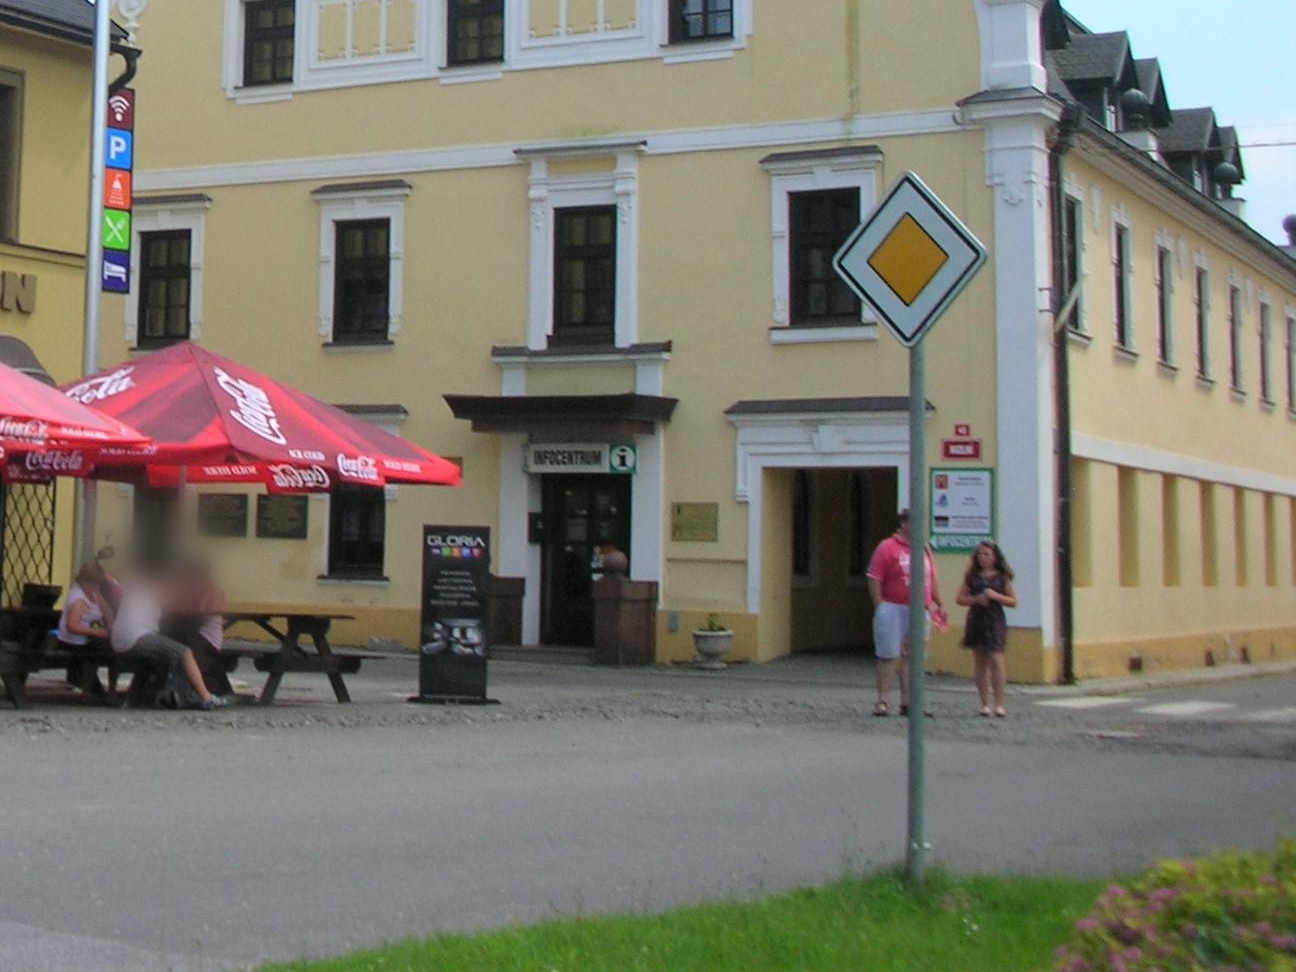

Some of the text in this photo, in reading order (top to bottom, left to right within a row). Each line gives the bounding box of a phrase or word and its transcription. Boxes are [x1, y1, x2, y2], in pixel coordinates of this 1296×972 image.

[110, 136, 127, 161] P
[533, 449, 603, 466] INFOCENTRUM
[426, 535, 486, 548] GLORIA
